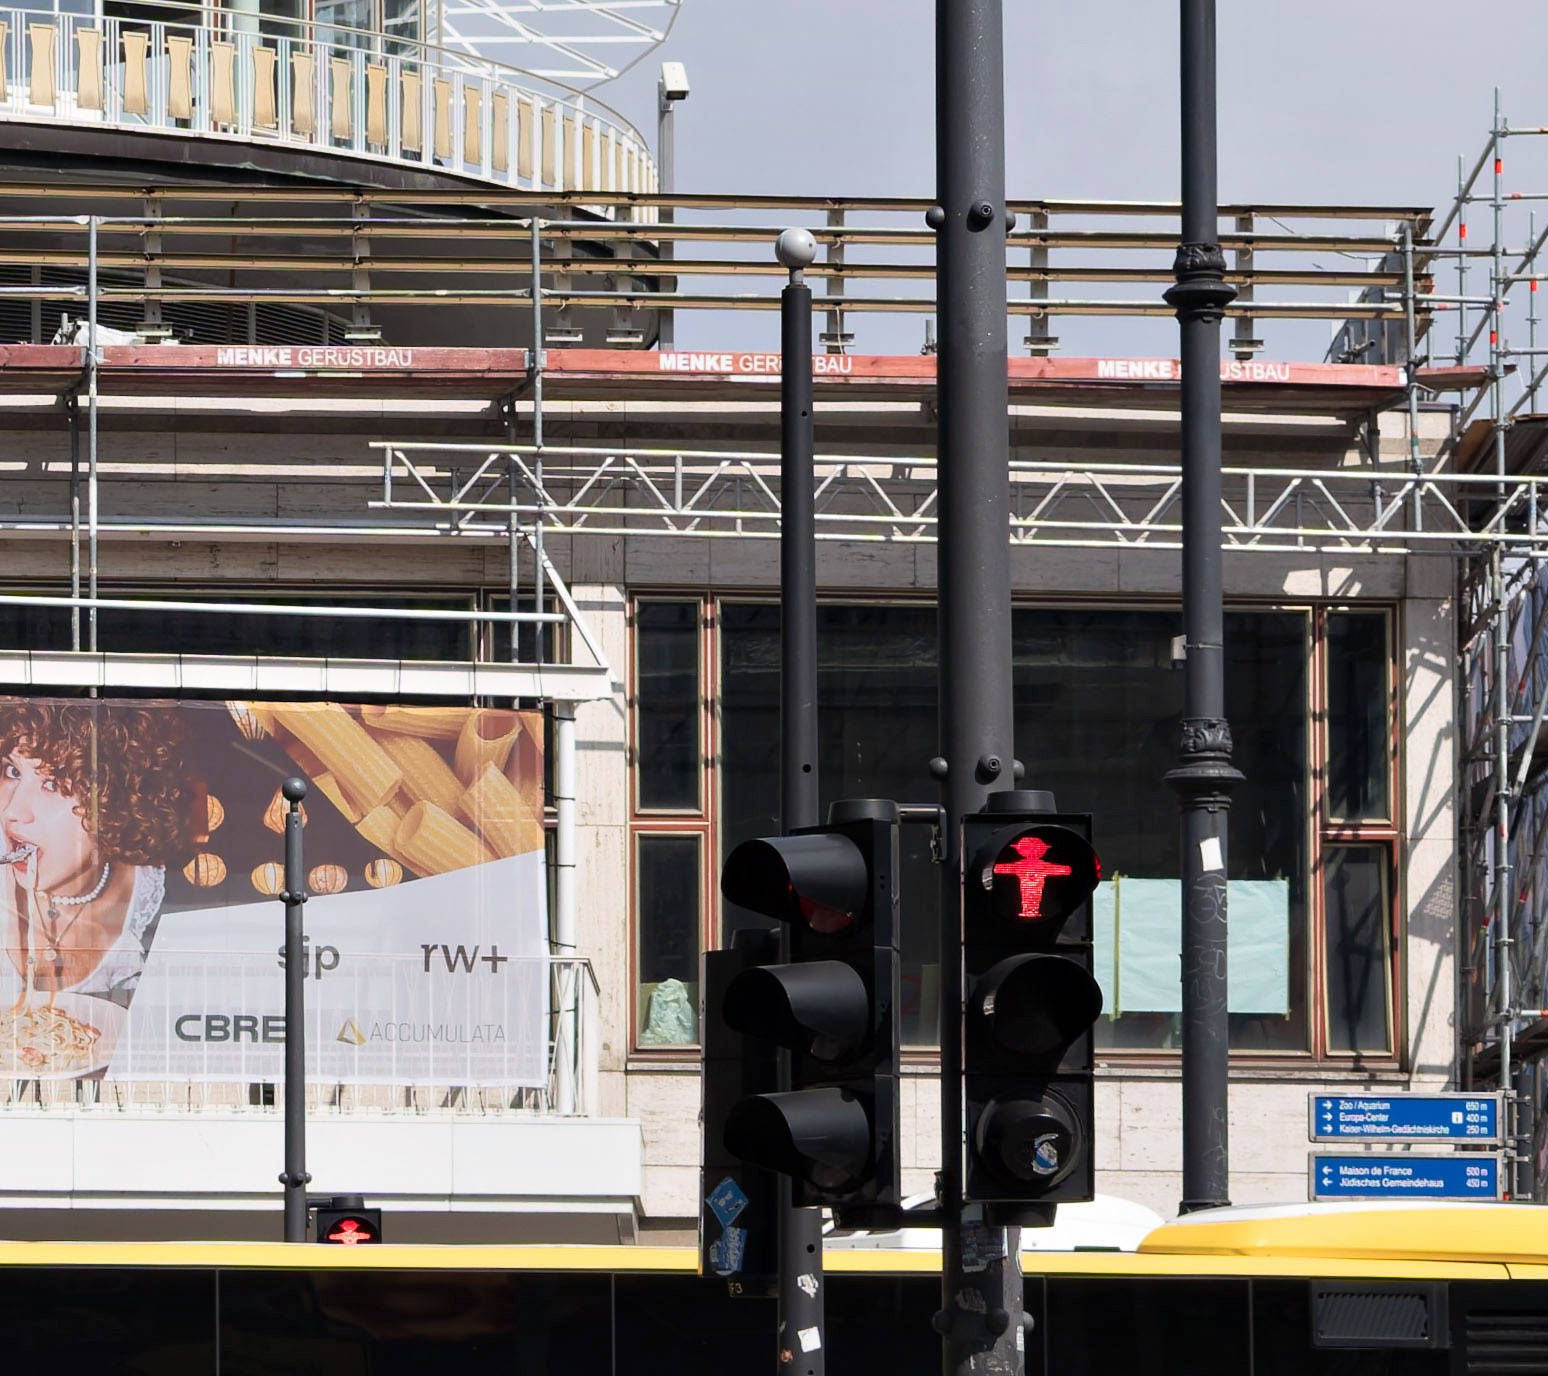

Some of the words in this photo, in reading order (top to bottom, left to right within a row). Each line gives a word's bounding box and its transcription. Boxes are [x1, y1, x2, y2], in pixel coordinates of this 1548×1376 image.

[217, 348, 292, 365] MENKE
[298, 349, 412, 367] GERÜSTBAU
[659, 354, 733, 372] MENKE
[739, 355, 852, 374] GERBAU
[1097, 361, 1173, 378] MENKE
[420, 943, 508, 974] rw+
[174, 1014, 286, 1044] CBRE
[370, 1022, 506, 1044] ACCUMULATA
[1339, 1101, 1354, 1110] Zoo
[1358, 1101, 1391, 1112] Aquarium
[1466, 1102, 1479, 1110] 650
[1339, 1113, 1389, 1123] Europa-Center
[1466, 1114, 1479, 1122] 400
[1339, 1125, 1450, 1134] Kaiser-Wilhelm-Gedächtniskirche
[1466, 1126, 1479, 1134] 250
[1339, 1167, 1370, 1175] Maison
[1371, 1167, 1382, 1175] de
[1384, 1167, 1412, 1175] France
[1466, 1167, 1479, 1176] 500
[1339, 1178, 1380, 1187] Jüdisches
[1382, 1178, 1444, 1187] Gemeindehaus
[1466, 1179, 1479, 1188] 450
